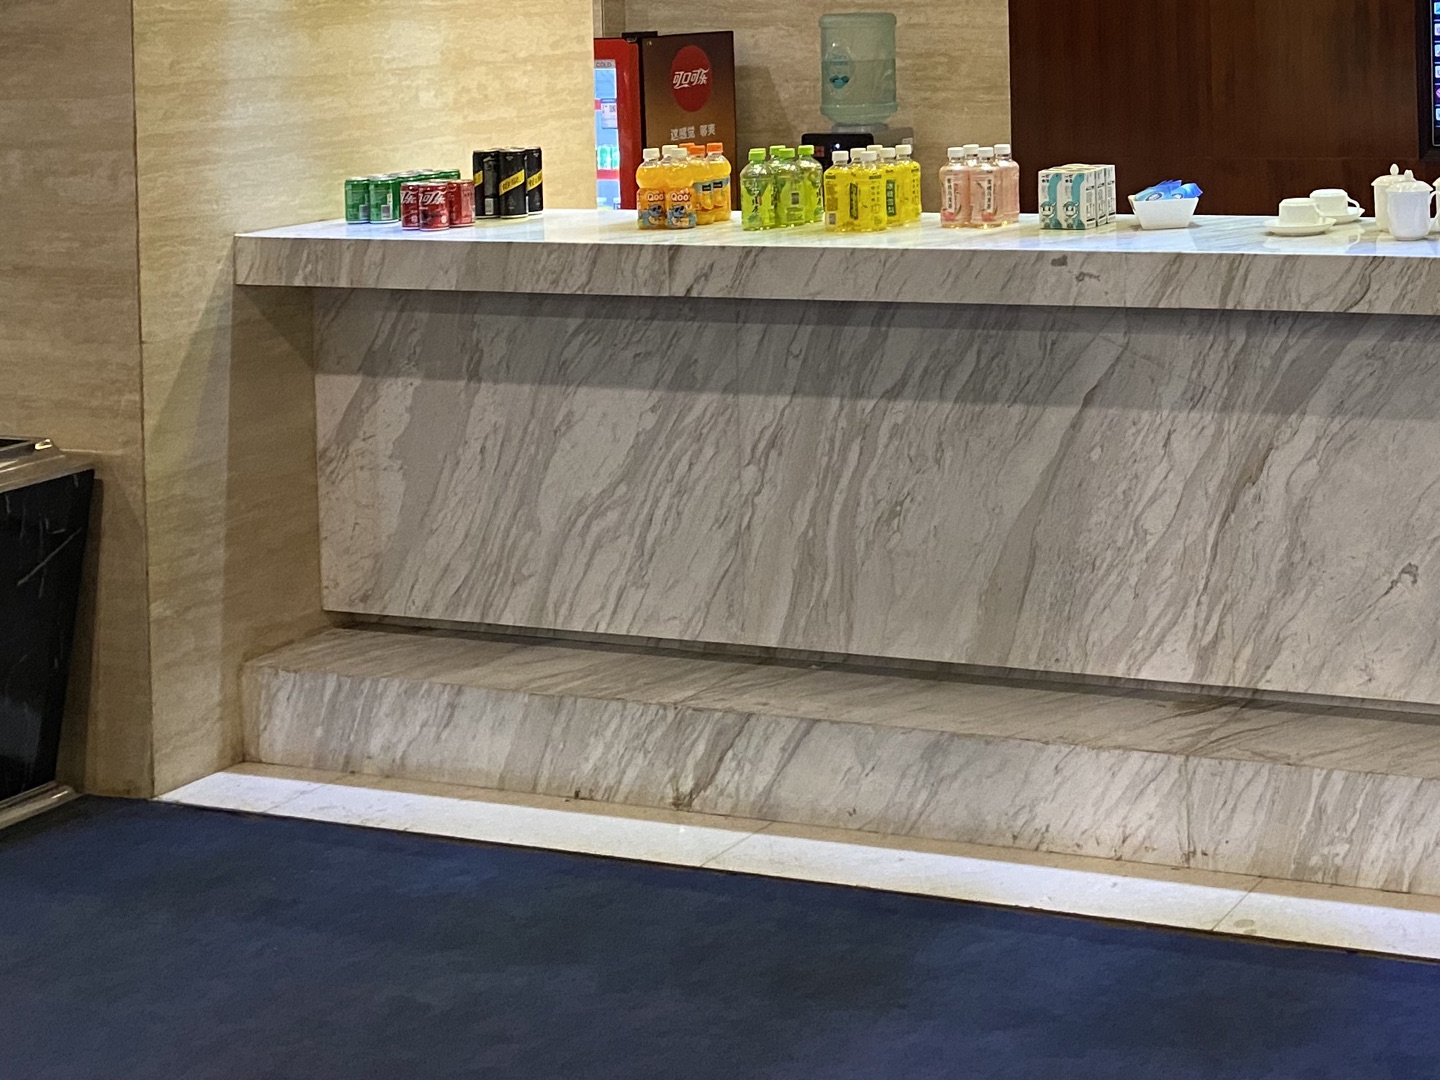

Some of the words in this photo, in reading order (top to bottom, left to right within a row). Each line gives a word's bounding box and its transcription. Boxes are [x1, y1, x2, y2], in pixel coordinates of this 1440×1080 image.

[672, 68, 710, 89] 可口可乐
[670, 125, 695, 141] 这感觉
[670, 192, 690, 202] Qoo
